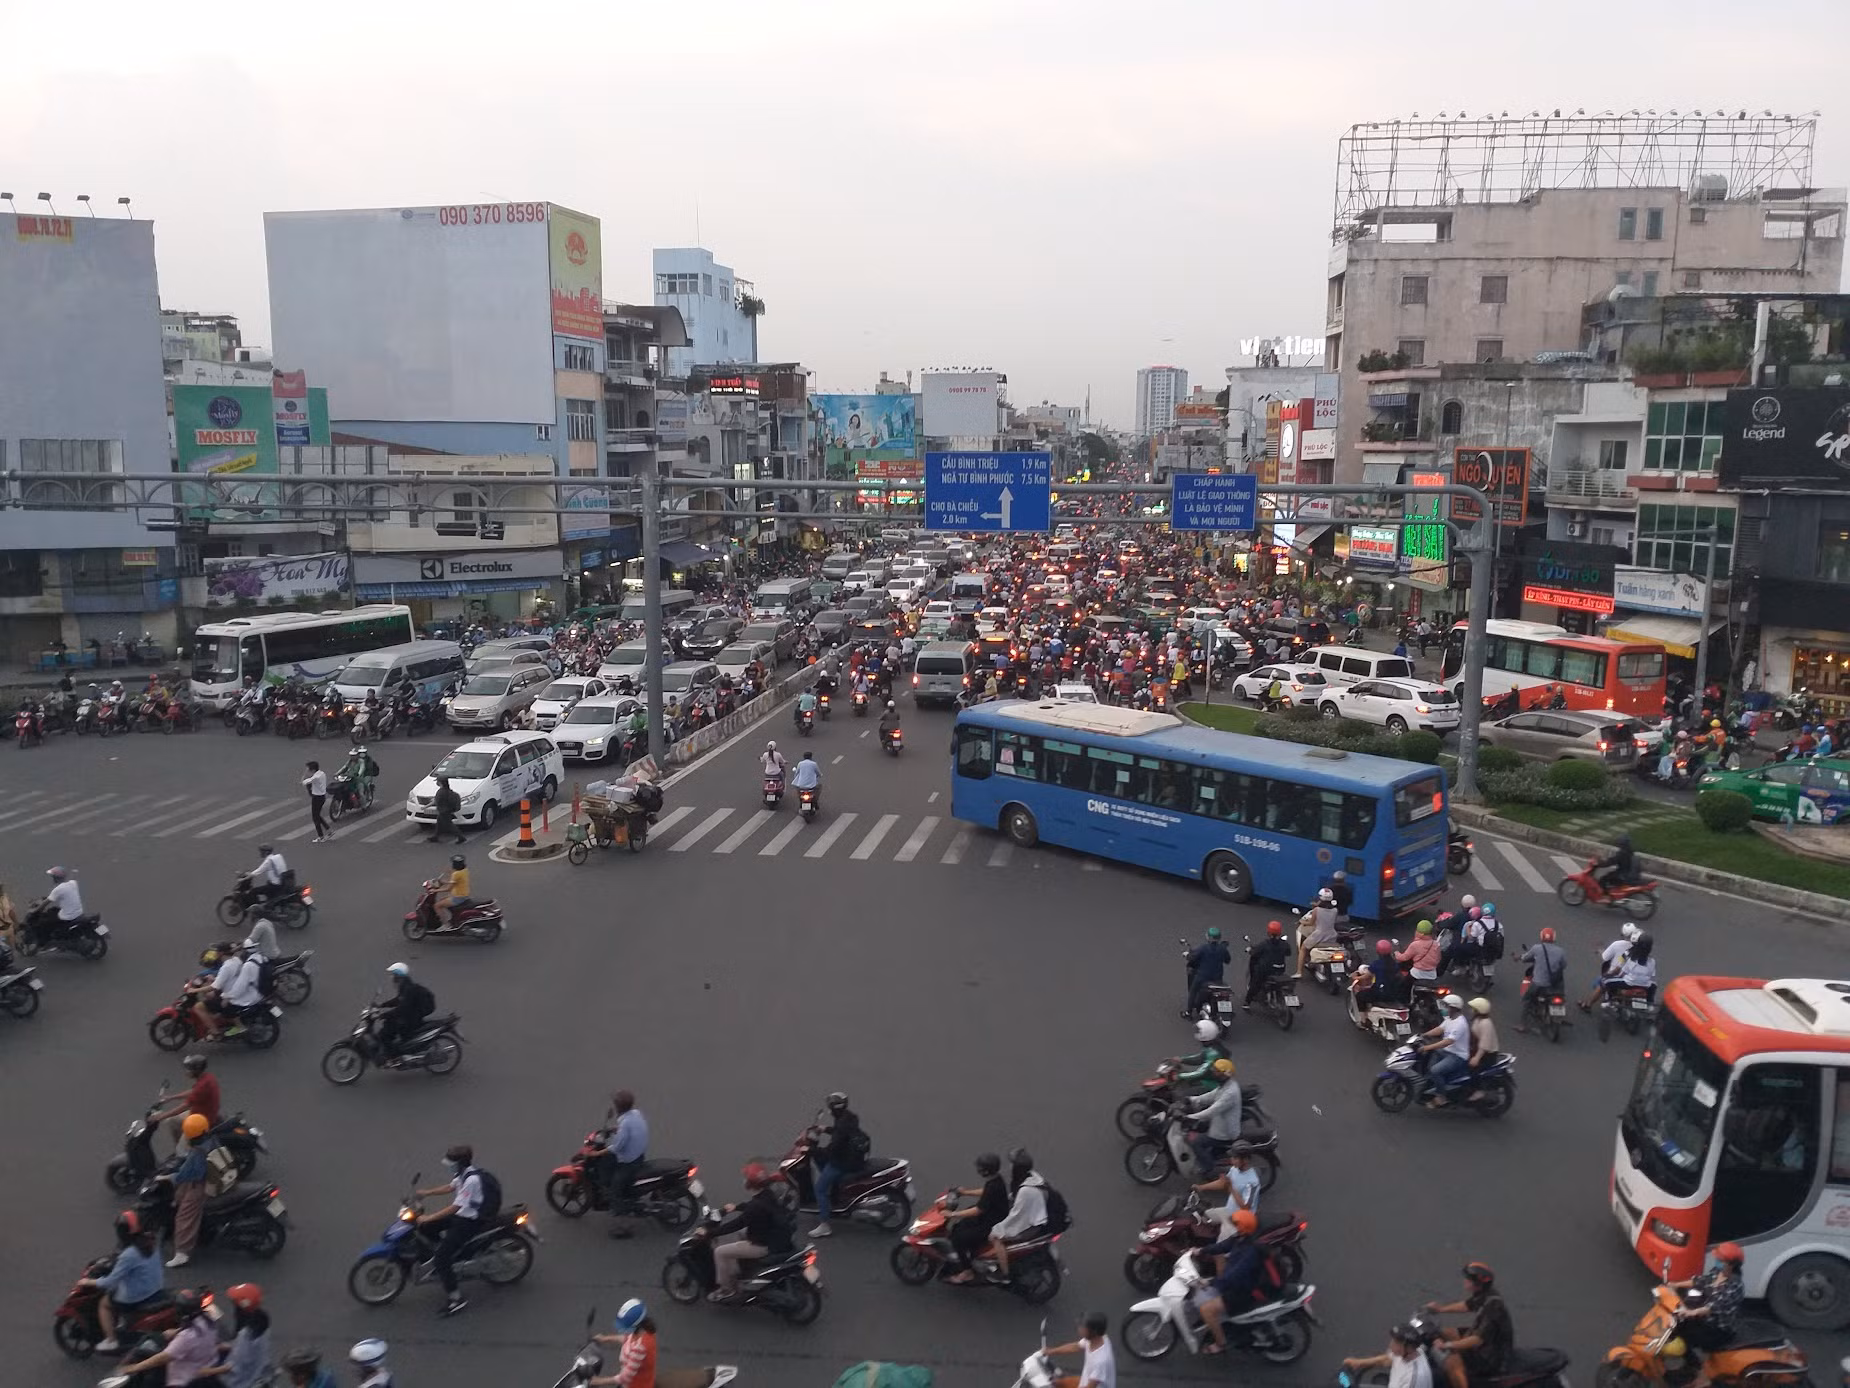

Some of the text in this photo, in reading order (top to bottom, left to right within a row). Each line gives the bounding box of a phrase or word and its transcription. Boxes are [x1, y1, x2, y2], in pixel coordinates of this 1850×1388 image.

[440, 203, 544, 225] 090 370 8596
[1316, 410, 1336, 418] LỘC
[198, 431, 256, 443] MOSFLY
[1743, 427, 1785, 440] Legend
[958, 456, 976, 469] BÌNH
[978, 457, 998, 470] TRIỆU
[1034, 458, 1046, 469] Km
[942, 471, 956, 484] NGÃ
[958, 473, 968, 484] TƯ
[970, 471, 987, 484] BÌNH
[989, 470, 1014, 484] PHƯỚC
[1034, 474, 1046, 484] Km
[1208, 492, 1225, 500] GIAO
[1227, 490, 1250, 500] THÔNG
[931, 502, 946, 512] CHỢ
[947, 500, 956, 512] BÀ
[1184, 502, 1244, 513] LÀ BẢO VỆ MÌNH
[955, 514, 967, 524] km
[1201, 517, 1215, 526] MỌI
[1218, 515, 1240, 525] NGƯỜI
[260, 561, 304, 582] Hoa
[450, 561, 513, 574] Electrolux
[1087, 799, 1110, 815] CNG
